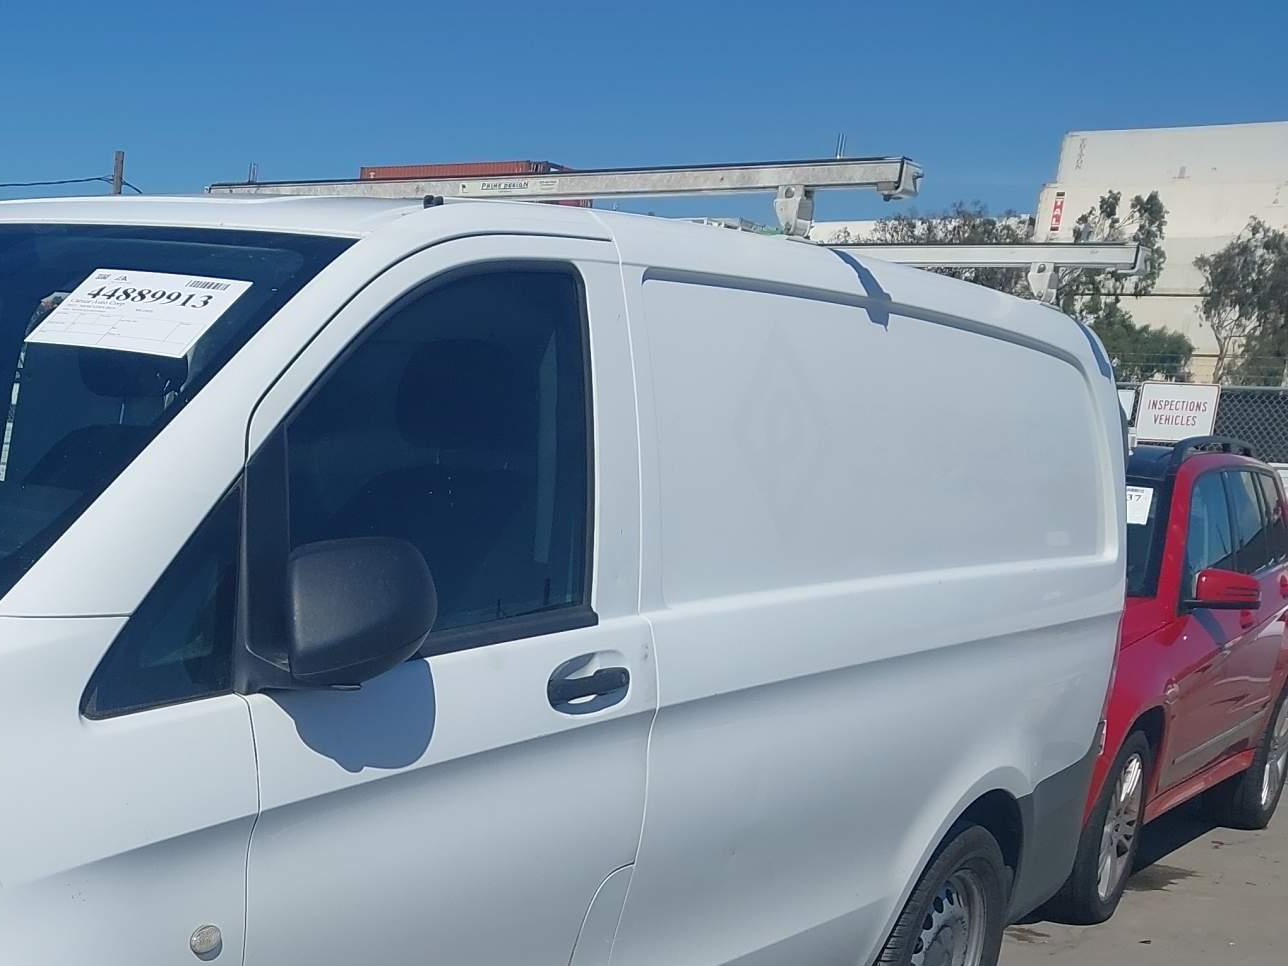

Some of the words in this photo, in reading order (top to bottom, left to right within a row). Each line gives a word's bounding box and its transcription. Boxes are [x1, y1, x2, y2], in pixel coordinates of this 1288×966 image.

[87, 286, 213, 308] 44889913
[1147, 399, 1208, 412] INSPECTIONS
[1153, 414, 1197, 426] VEHICLES
